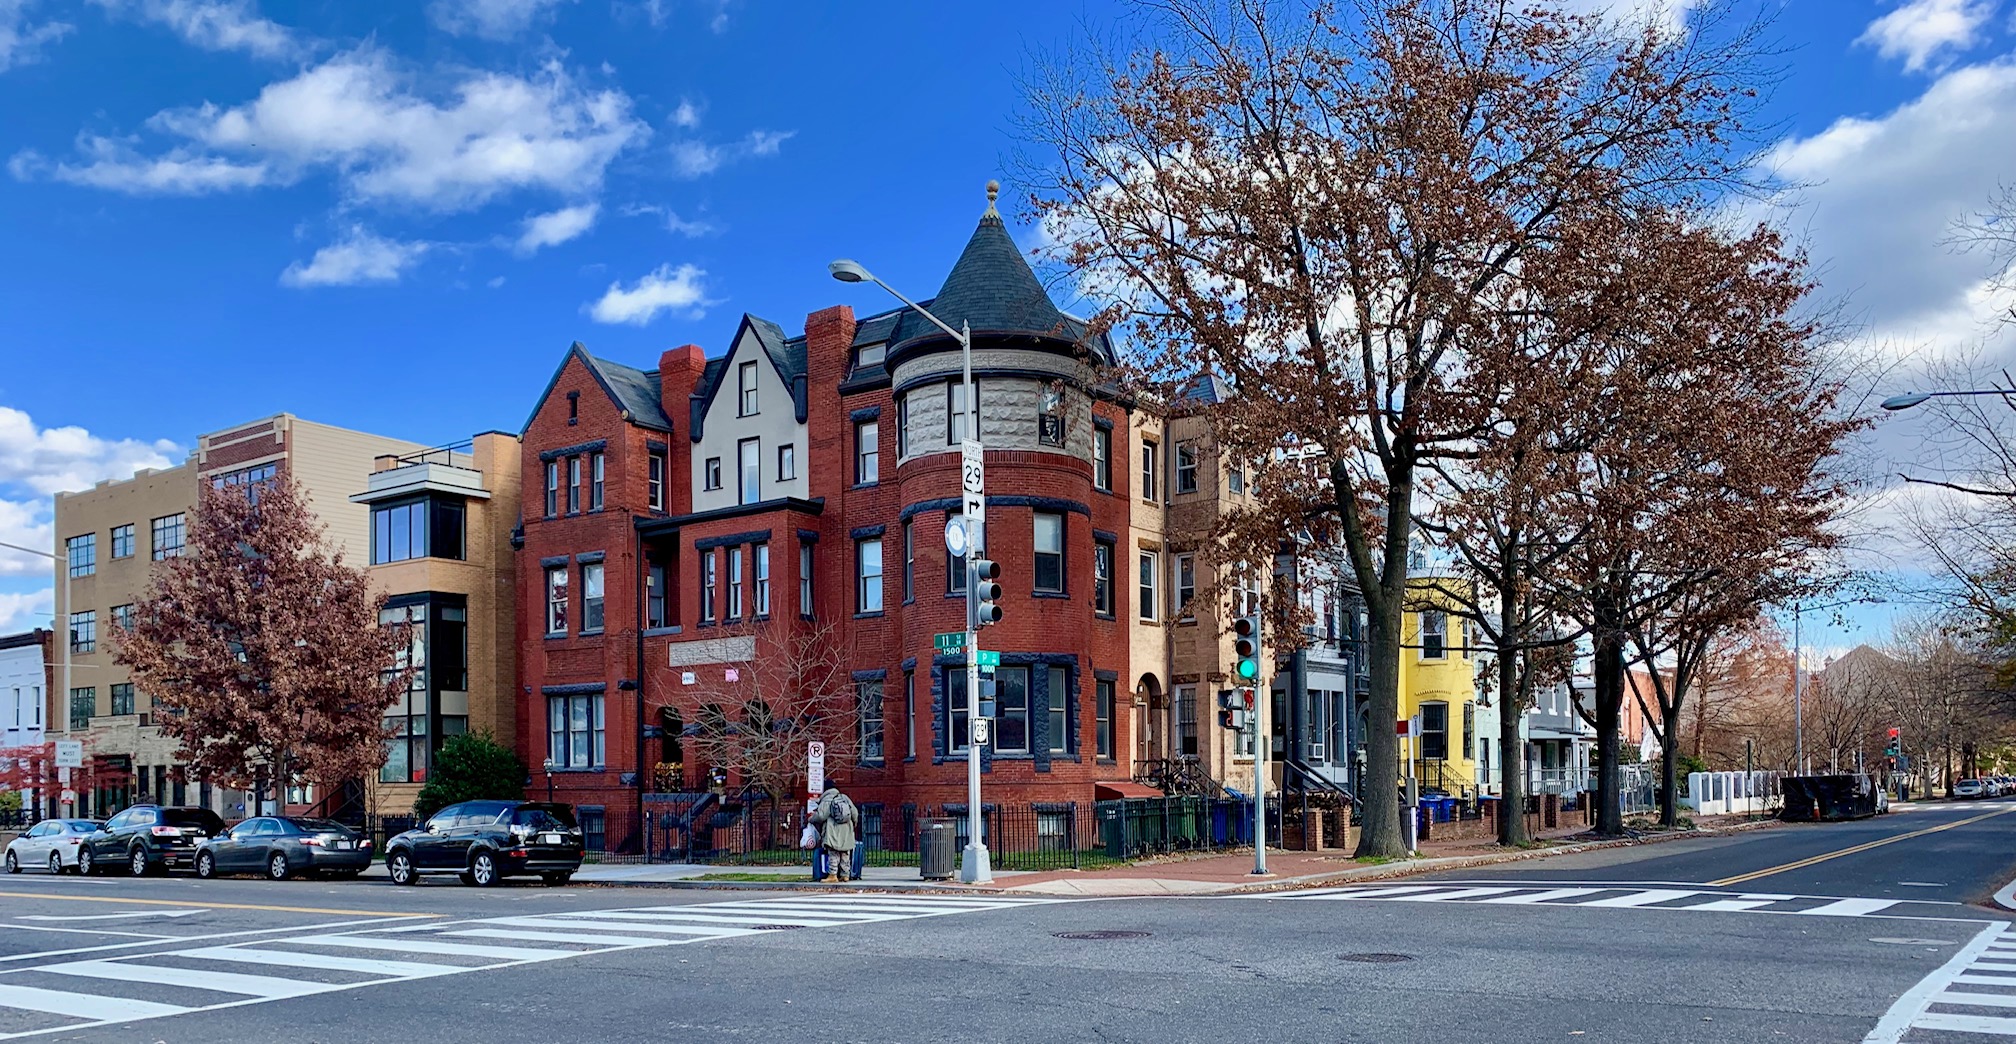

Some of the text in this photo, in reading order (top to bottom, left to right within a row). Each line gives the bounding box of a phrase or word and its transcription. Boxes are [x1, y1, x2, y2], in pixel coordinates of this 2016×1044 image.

[964, 444, 981, 457] NORTH
[966, 466, 980, 485] 29
[942, 635, 949, 647] 11
[943, 647, 961, 656] 1500
[982, 653, 987, 662] P
[982, 665, 995, 673] 1000
[976, 723, 984, 737] 29
